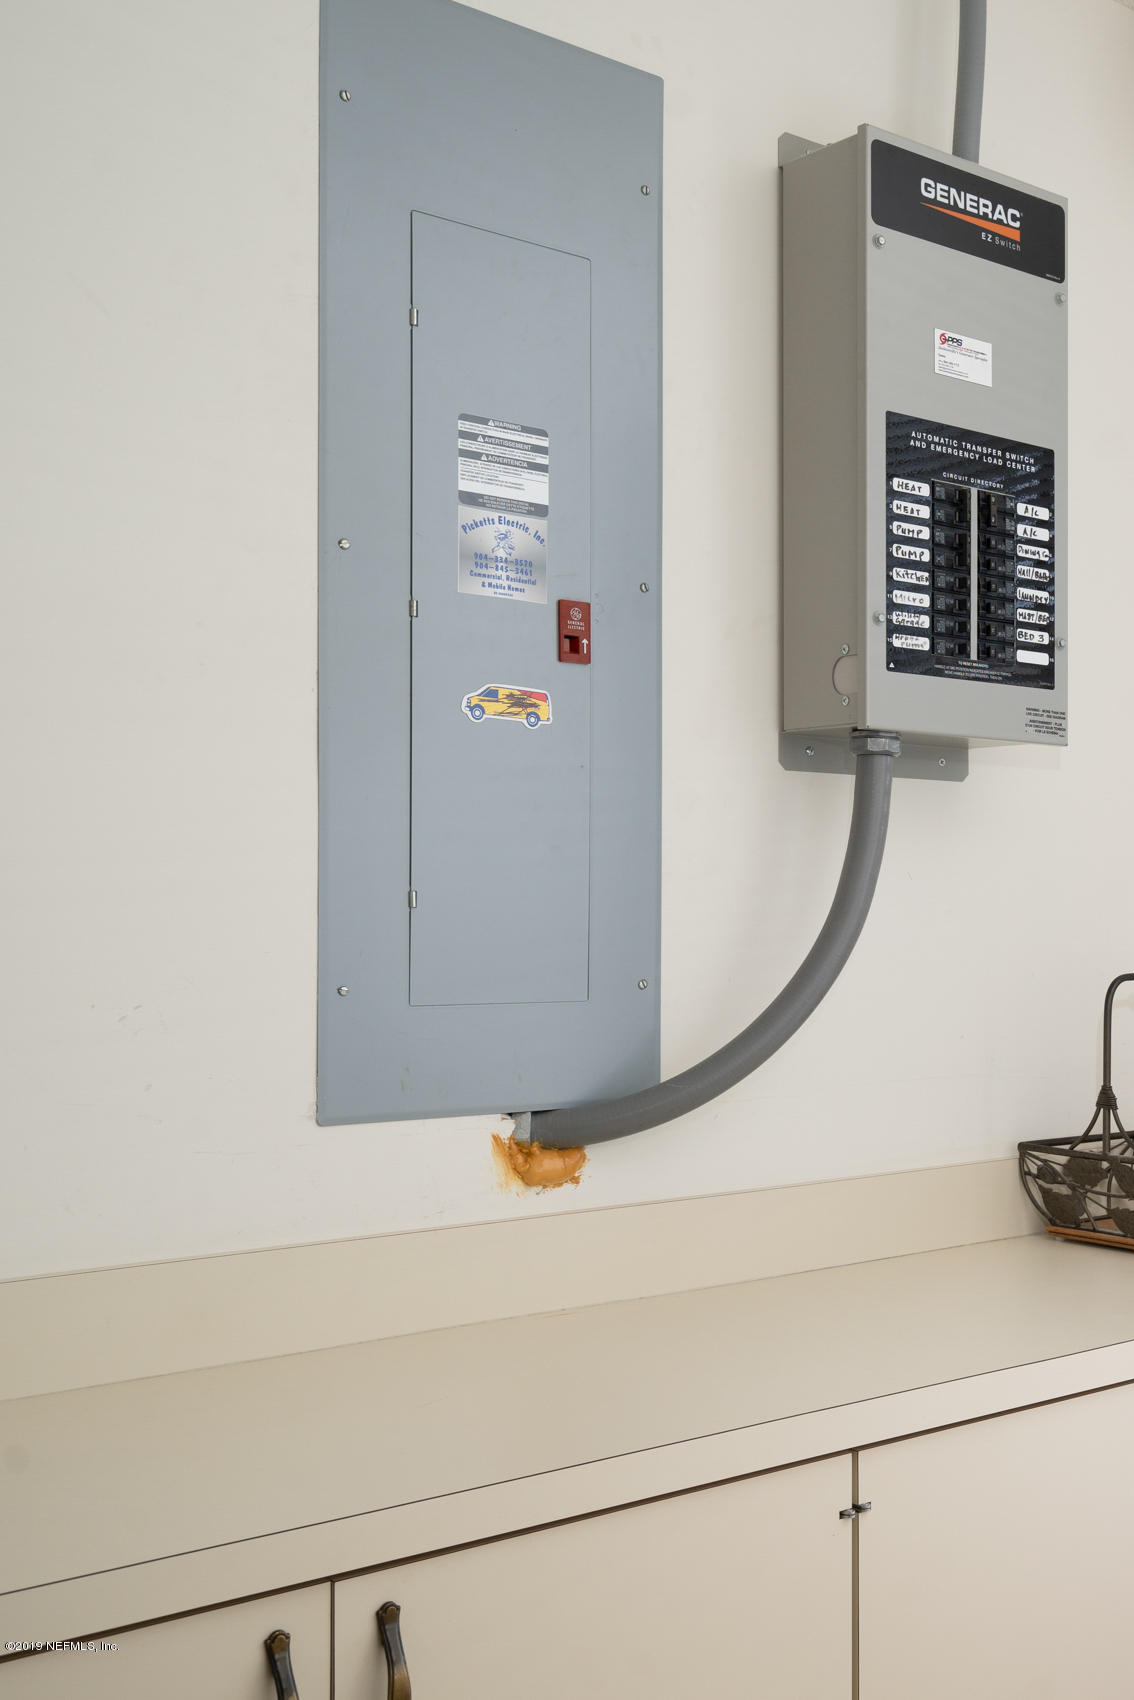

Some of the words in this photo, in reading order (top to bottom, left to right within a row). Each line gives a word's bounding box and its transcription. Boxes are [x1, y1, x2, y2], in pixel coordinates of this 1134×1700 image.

[920, 177, 1021, 228] GENERAC
[981, 232, 993, 242] EZ
[995, 236, 1021, 252] Switch
[484, 437, 532, 451] AVERTISSEMENT
[911, 431, 958, 447] AUTOMATIC
[962, 442, 1002, 457] TRANSFER
[1005, 451, 1035, 465] SWITCH
[488, 455, 528, 468] ADVERTENCIA
[910, 439, 927, 449] AND
[930, 443, 980, 460] EMERGENCY
[983, 455, 1003, 466] LOAD
[1006, 459, 1036, 473] CENTER
[897, 480, 922, 493] HEAT
[942, 471, 968, 482] CIRCUIT
[970, 477, 1004, 489] DIRECTORY
[896, 503, 921, 516] HEAT
[461, 516, 495, 535] Picketts
[533, 530, 546, 547] Inc.
[487, 582, 506, 590] Mobile
[505, 574, 537, 586] Residential
[1017, 630, 1035, 640] BED
[1038, 635, 1045, 643] 3
